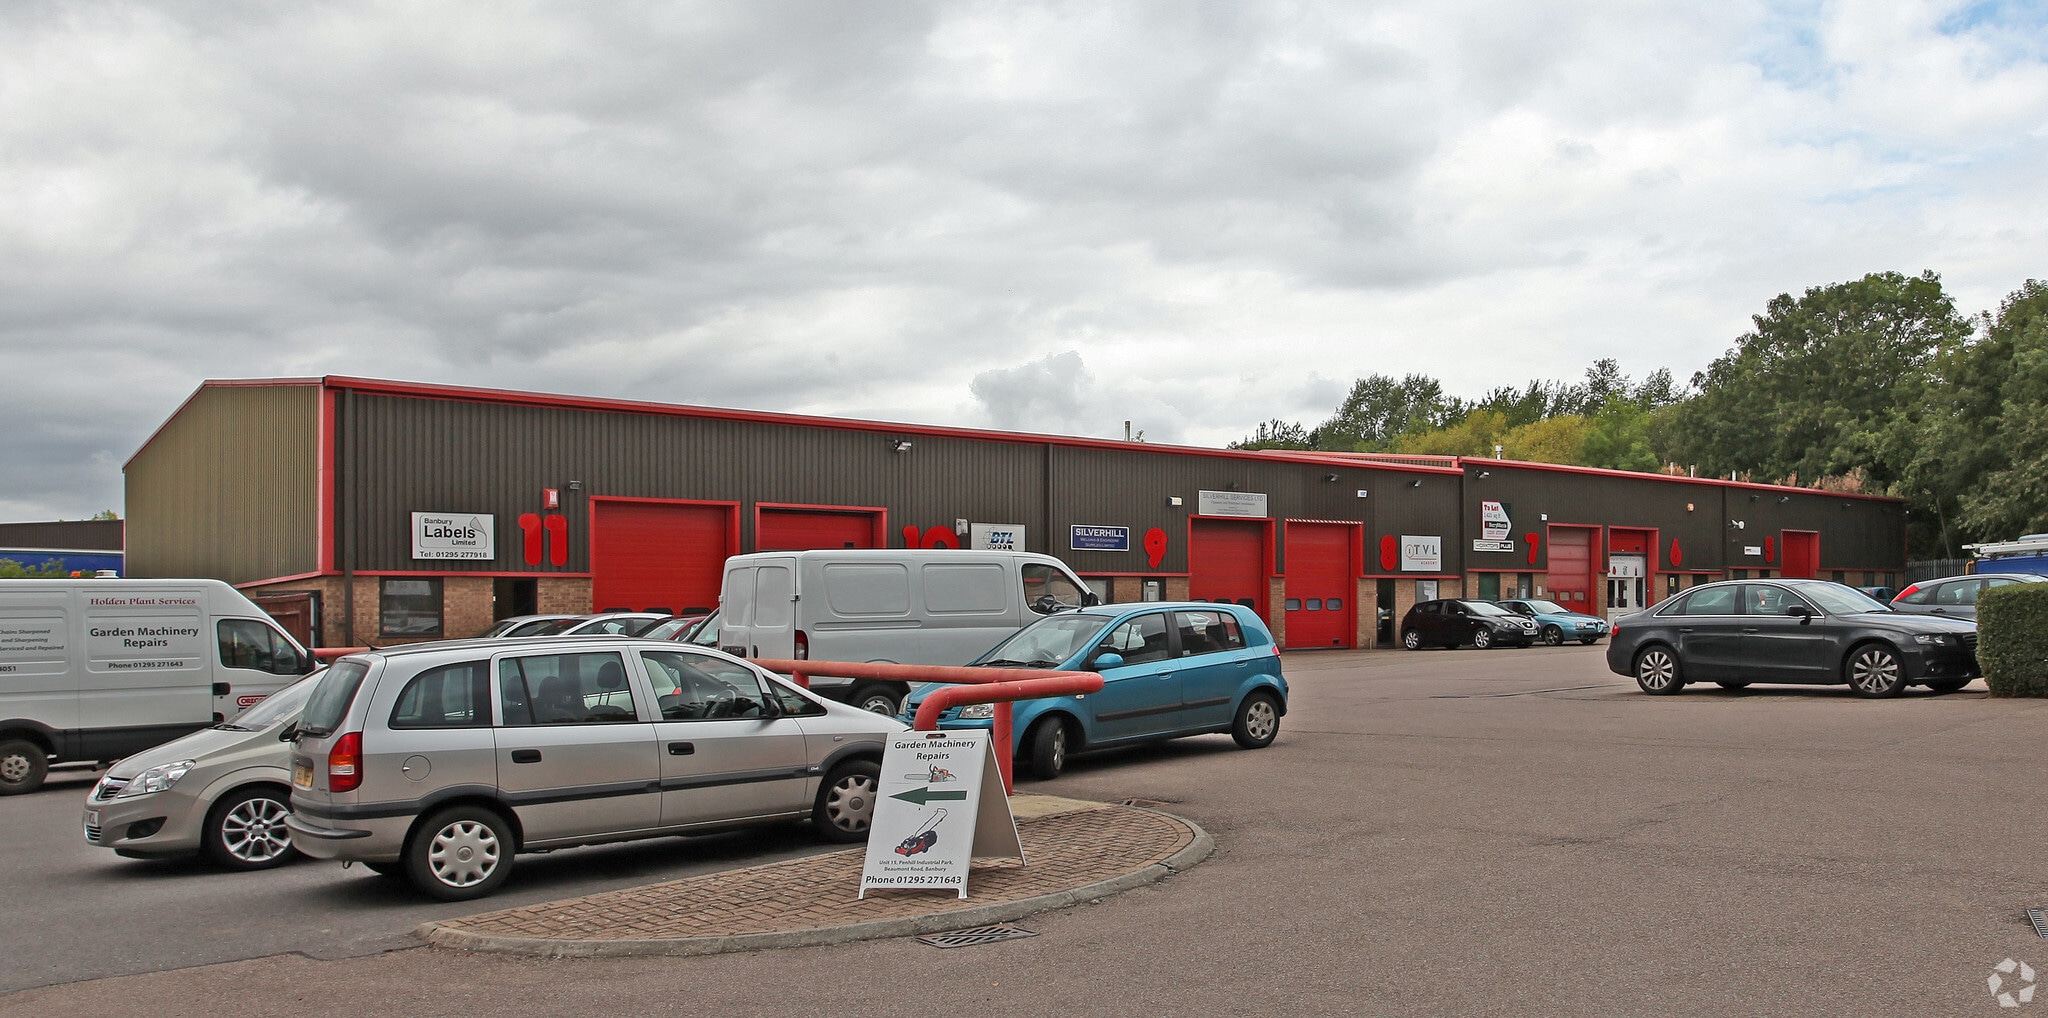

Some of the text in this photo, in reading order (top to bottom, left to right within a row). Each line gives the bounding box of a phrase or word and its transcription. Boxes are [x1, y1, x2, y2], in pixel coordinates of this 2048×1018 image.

[424, 517, 453, 525] Banbury
[424, 526, 476, 539] Labels
[990, 531, 1014, 544] BTL
[1075, 528, 1125, 538] SILVERHILL
[518, 513, 568, 567] 11
[1144, 527, 1168, 569] 9
[1380, 534, 1397, 571] 8
[1524, 532, 1540, 565] 7
[1669, 538, 1682, 566] 6
[460, 551, 487, 559] 277918
[90, 597, 196, 605] Holden Plant Services
[90, 626, 199, 637] Garden Machinery
[124, 638, 168, 649] Repairs
[894, 739, 976, 749] Garden Machinery
[916, 751, 950, 761] Repairs
[865, 875, 962, 884] Phone 01295 271643
